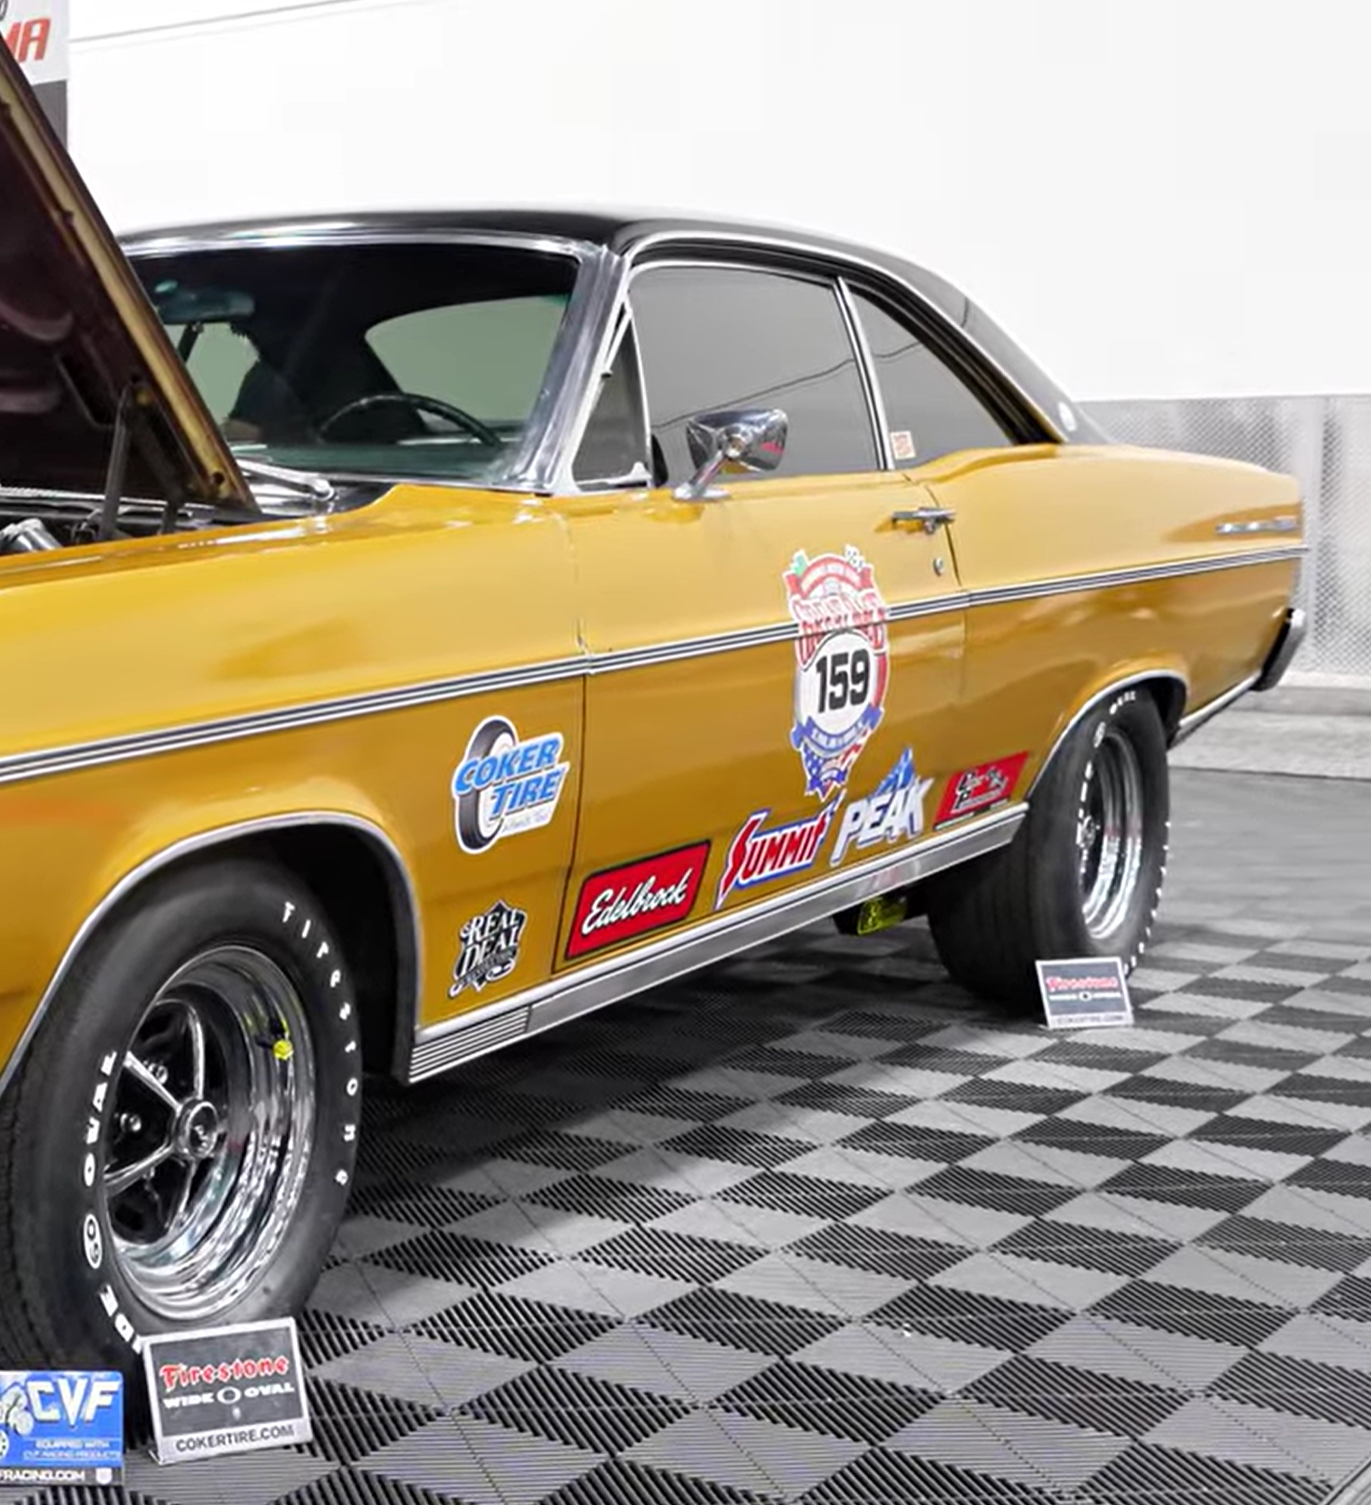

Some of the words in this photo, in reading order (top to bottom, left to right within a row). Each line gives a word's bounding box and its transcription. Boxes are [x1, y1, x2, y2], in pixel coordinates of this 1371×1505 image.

[816, 649, 870, 714] 159
[454, 737, 560, 792] COKER
[490, 769, 564, 817] TIRE
[830, 776, 934, 866] PEAK
[716, 803, 834, 908] SUMMIT
[581, 867, 693, 935] Edelbrock
[459, 926, 519, 978] DEAL
[460, 908, 520, 946] REAL
[159, 1354, 291, 1394] Firestone
[162, 1391, 216, 1410] WIDE
[244, 1382, 296, 1398] OVAL
[26, 1377, 120, 1428] CVF
[175, 1423, 295, 1453] COKERTIRE.COM
